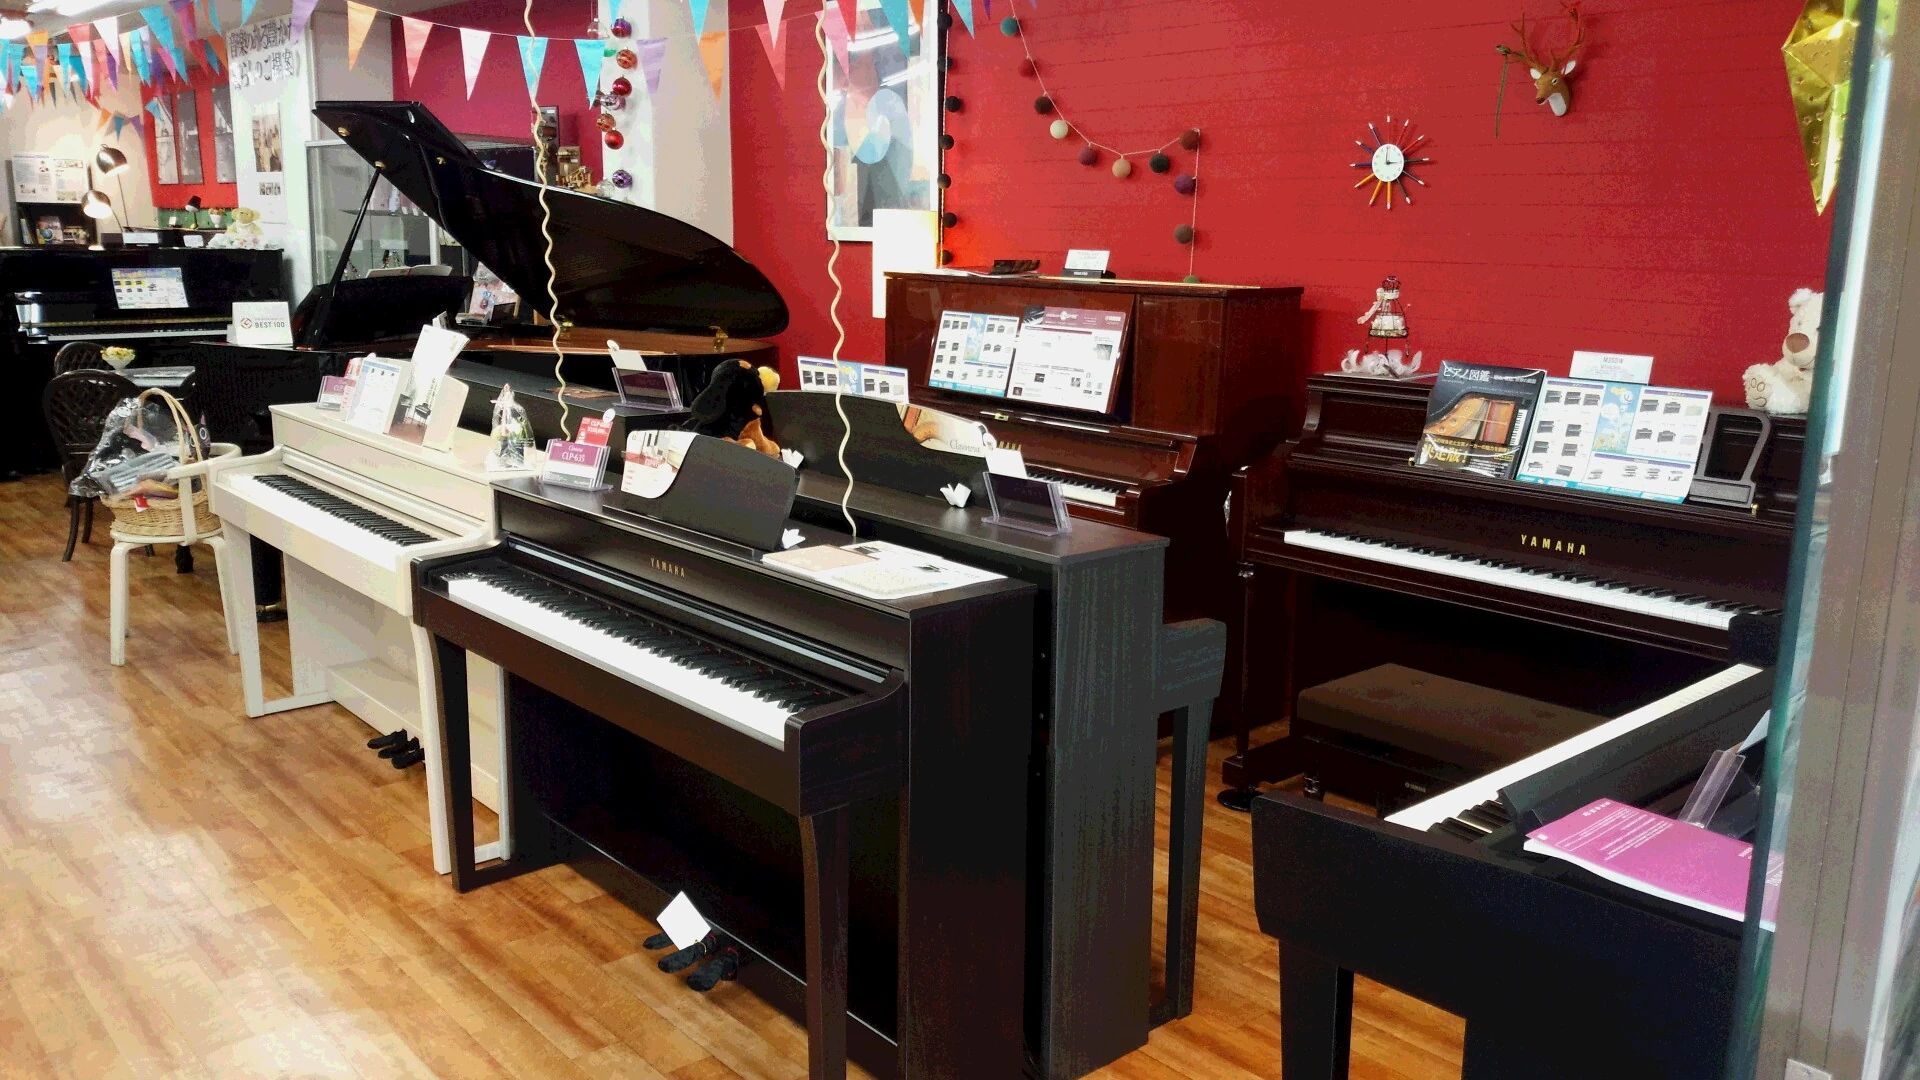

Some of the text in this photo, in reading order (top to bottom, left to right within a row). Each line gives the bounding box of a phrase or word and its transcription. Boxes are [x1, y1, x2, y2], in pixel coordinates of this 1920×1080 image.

[254, 321, 272, 329] BEST
[1520, 534, 1586, 556] YAMAHA
[650, 557, 686, 578] YAMAHA
